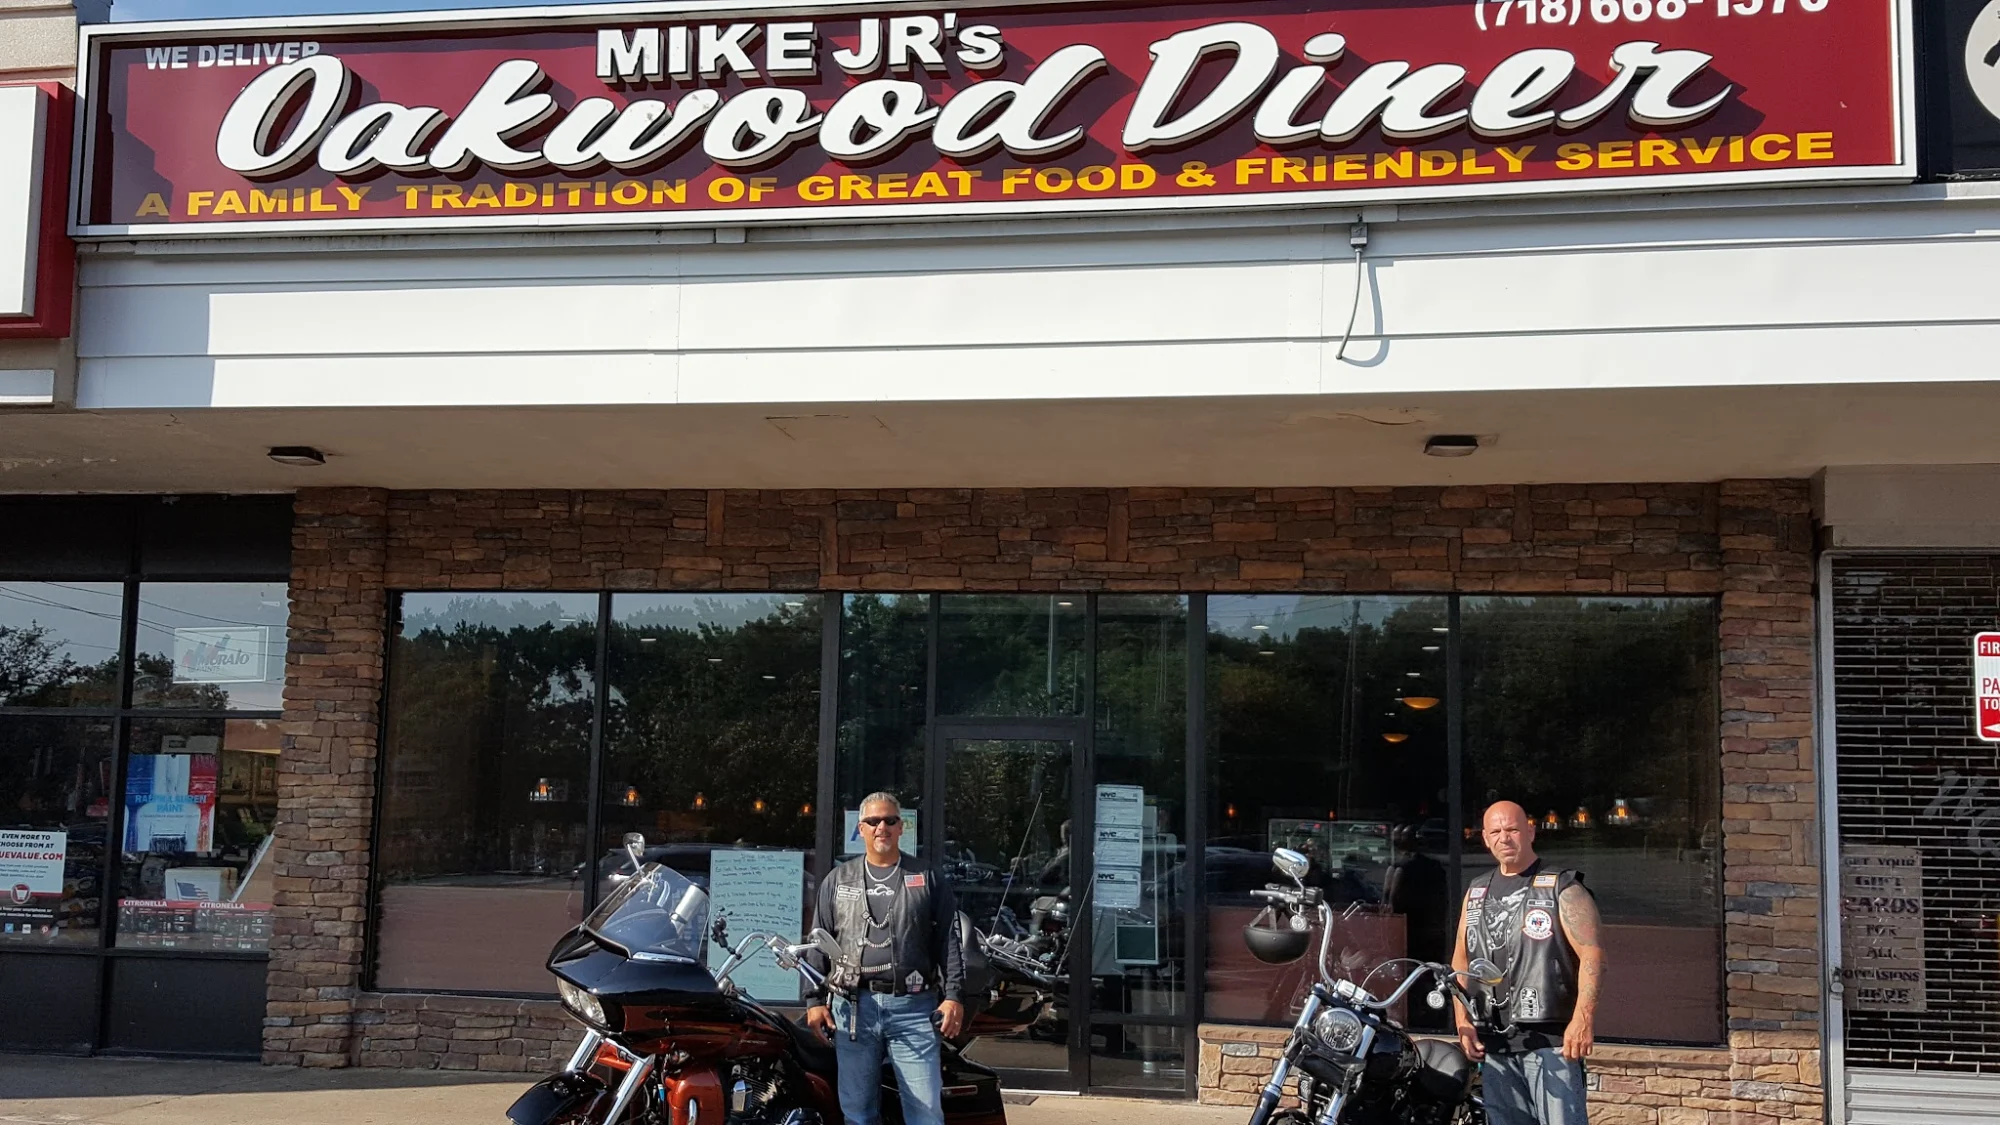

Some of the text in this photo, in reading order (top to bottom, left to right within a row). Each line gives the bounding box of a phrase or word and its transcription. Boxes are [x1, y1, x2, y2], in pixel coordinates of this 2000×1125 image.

[146, 47, 188, 69] WE
[596, 21, 817, 82] MIKE
[215, 21, 1731, 176] Oakwood Diner
[135, 131, 1834, 217] A FAMILY TRADITION OF GREAT FOOD & FRIENDLY SERVICE
[1877, 857, 1916, 867] YOUR
[123, 899, 167, 907] CITRONELLA
[1843, 896, 1920, 914] CARDS
[1842, 968, 1920, 982] OCCASIONS
[1857, 988, 1912, 1004] HERE
